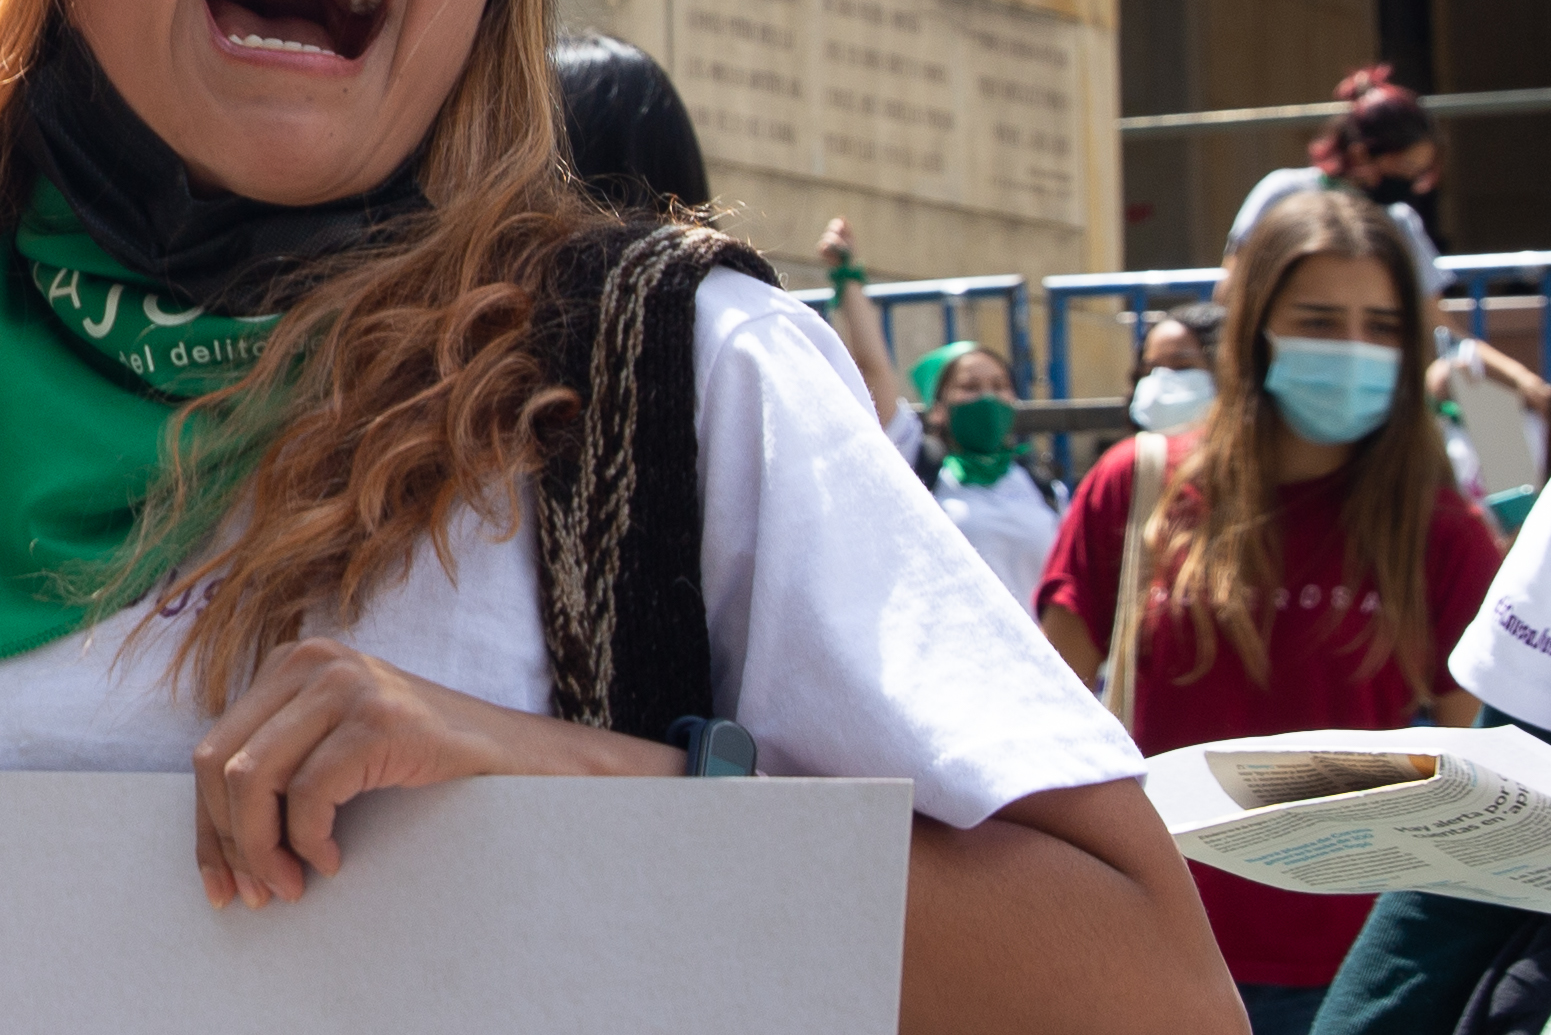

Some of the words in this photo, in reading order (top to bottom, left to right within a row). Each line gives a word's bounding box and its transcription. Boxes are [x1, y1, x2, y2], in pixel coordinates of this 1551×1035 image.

[1432, 811, 1484, 828] alerta
[1484, 785, 1510, 814] por
[1481, 816, 1506, 826] en
